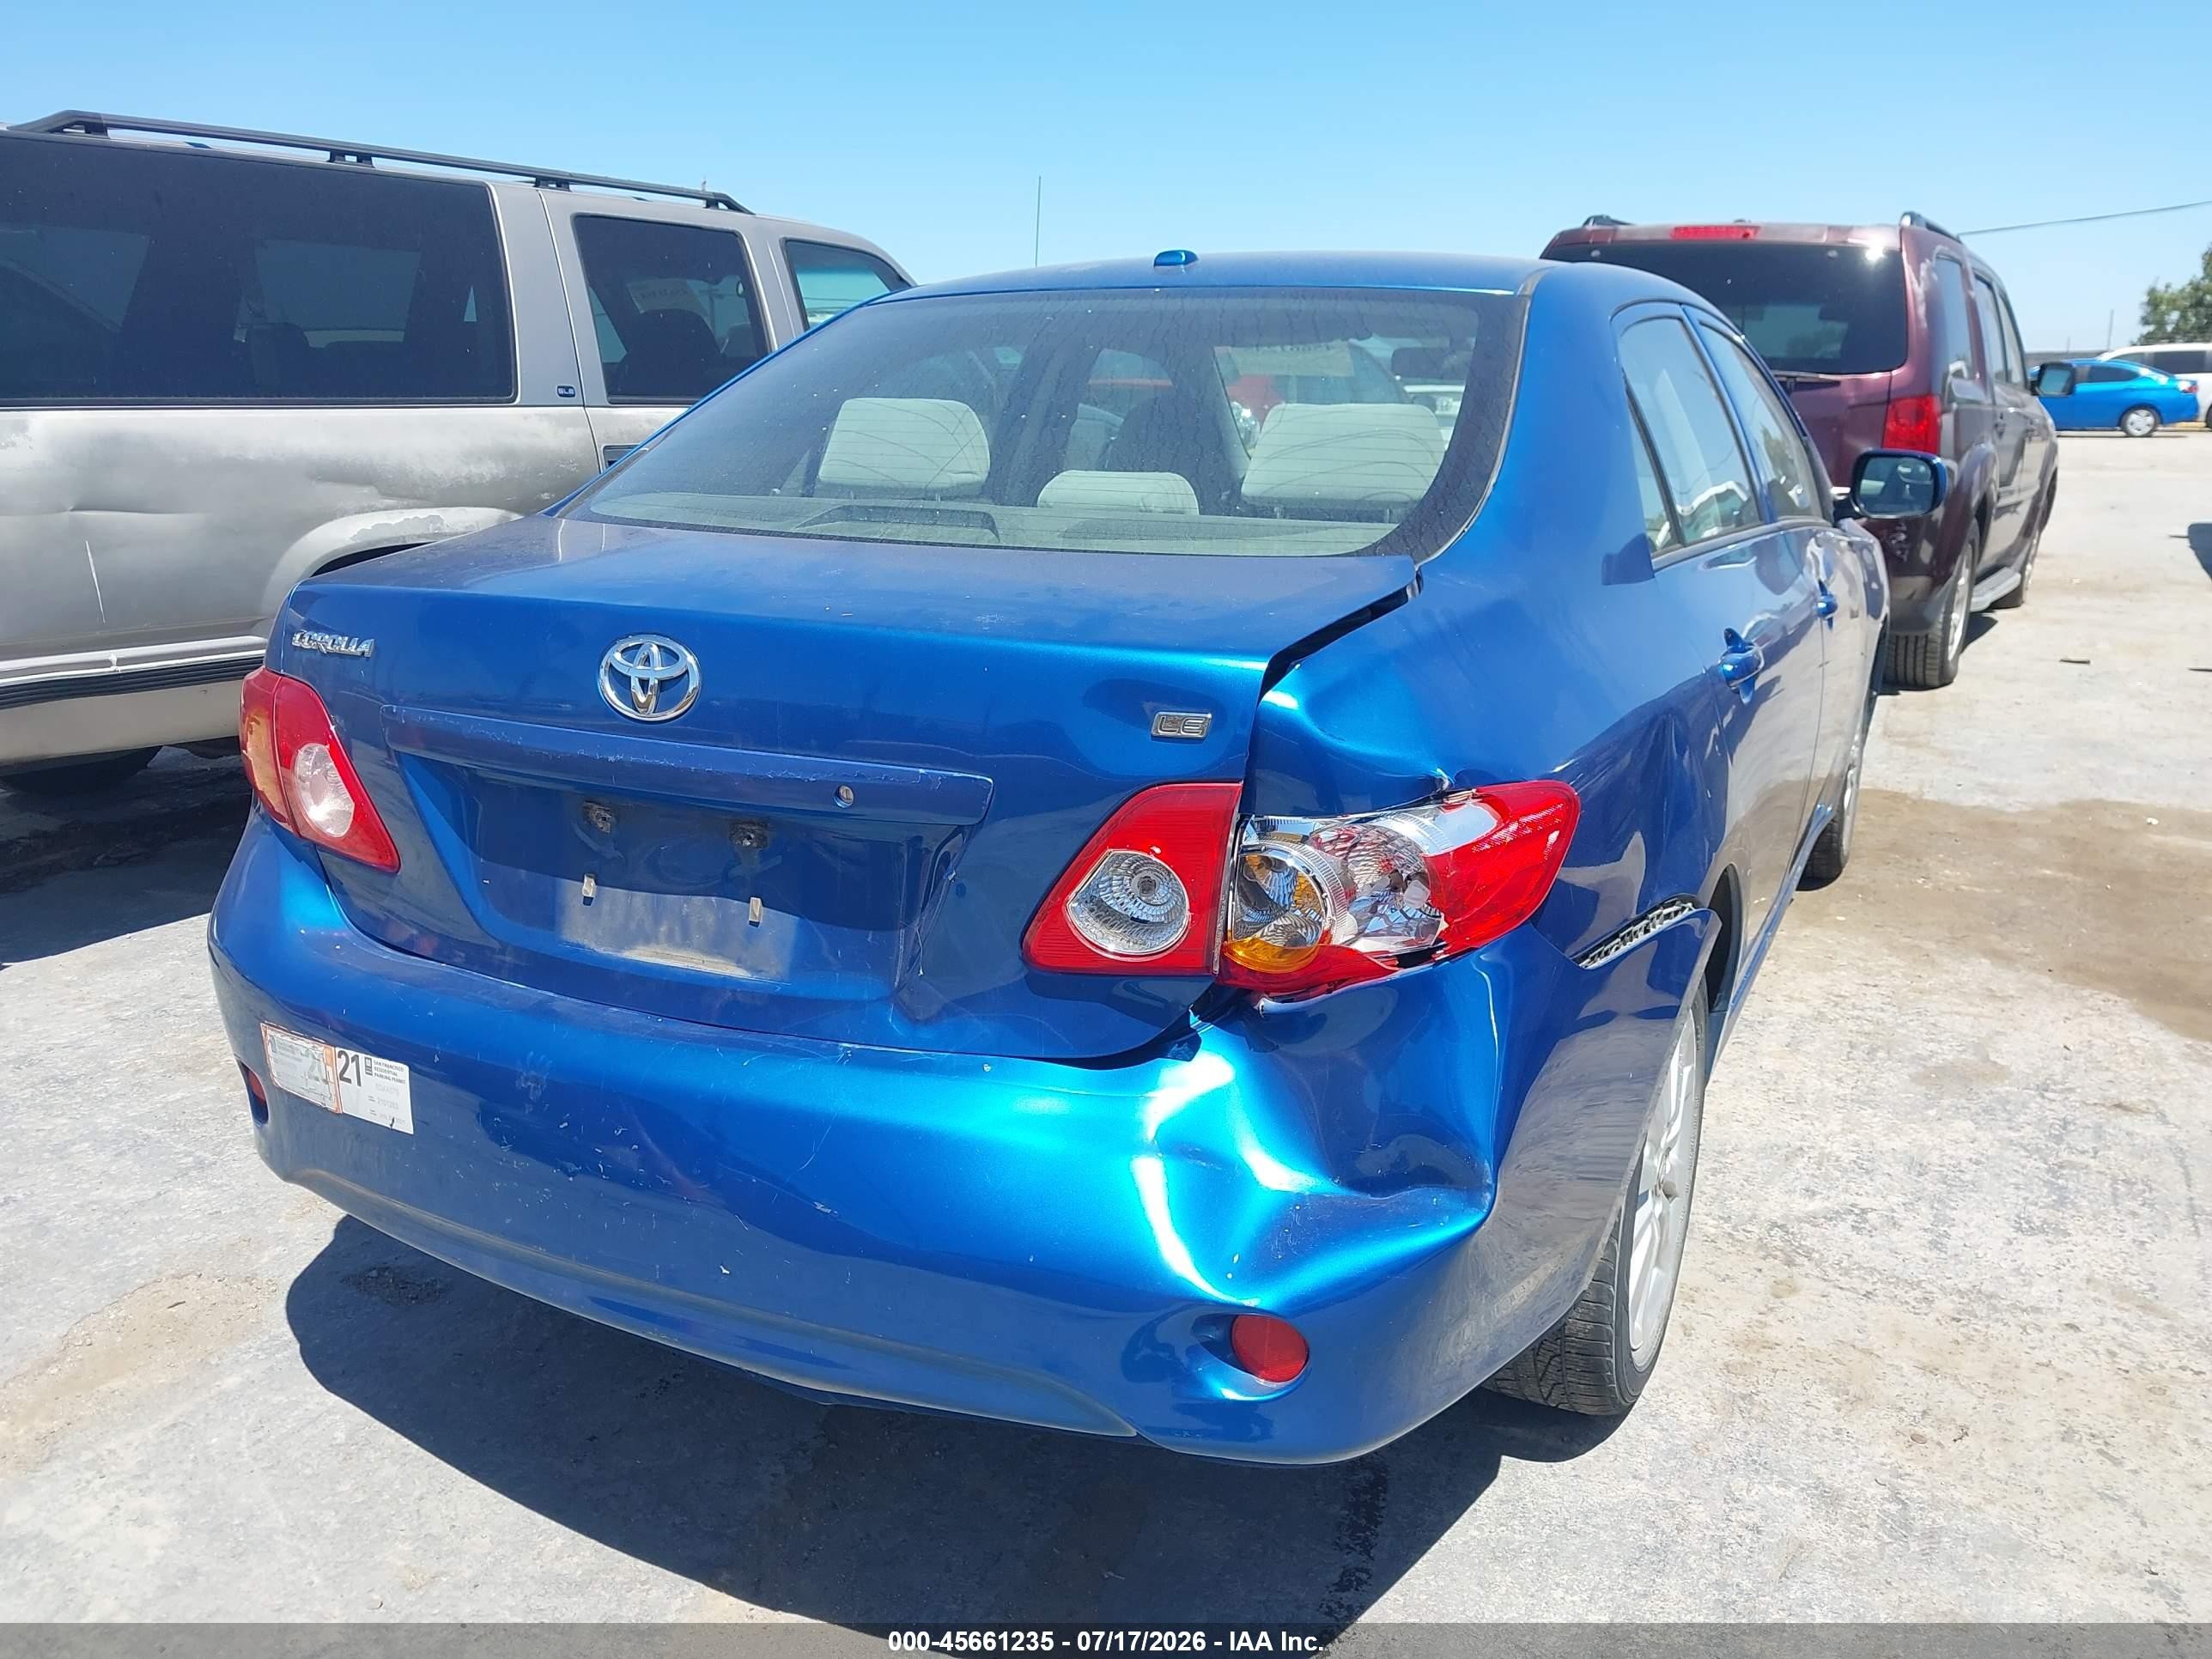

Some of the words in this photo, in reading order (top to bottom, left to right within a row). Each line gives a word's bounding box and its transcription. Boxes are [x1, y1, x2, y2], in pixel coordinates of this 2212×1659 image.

[292, 629, 374, 657] COROLLA
[1158, 715, 1206, 736] LE
[337, 1049, 362, 1087] 21
